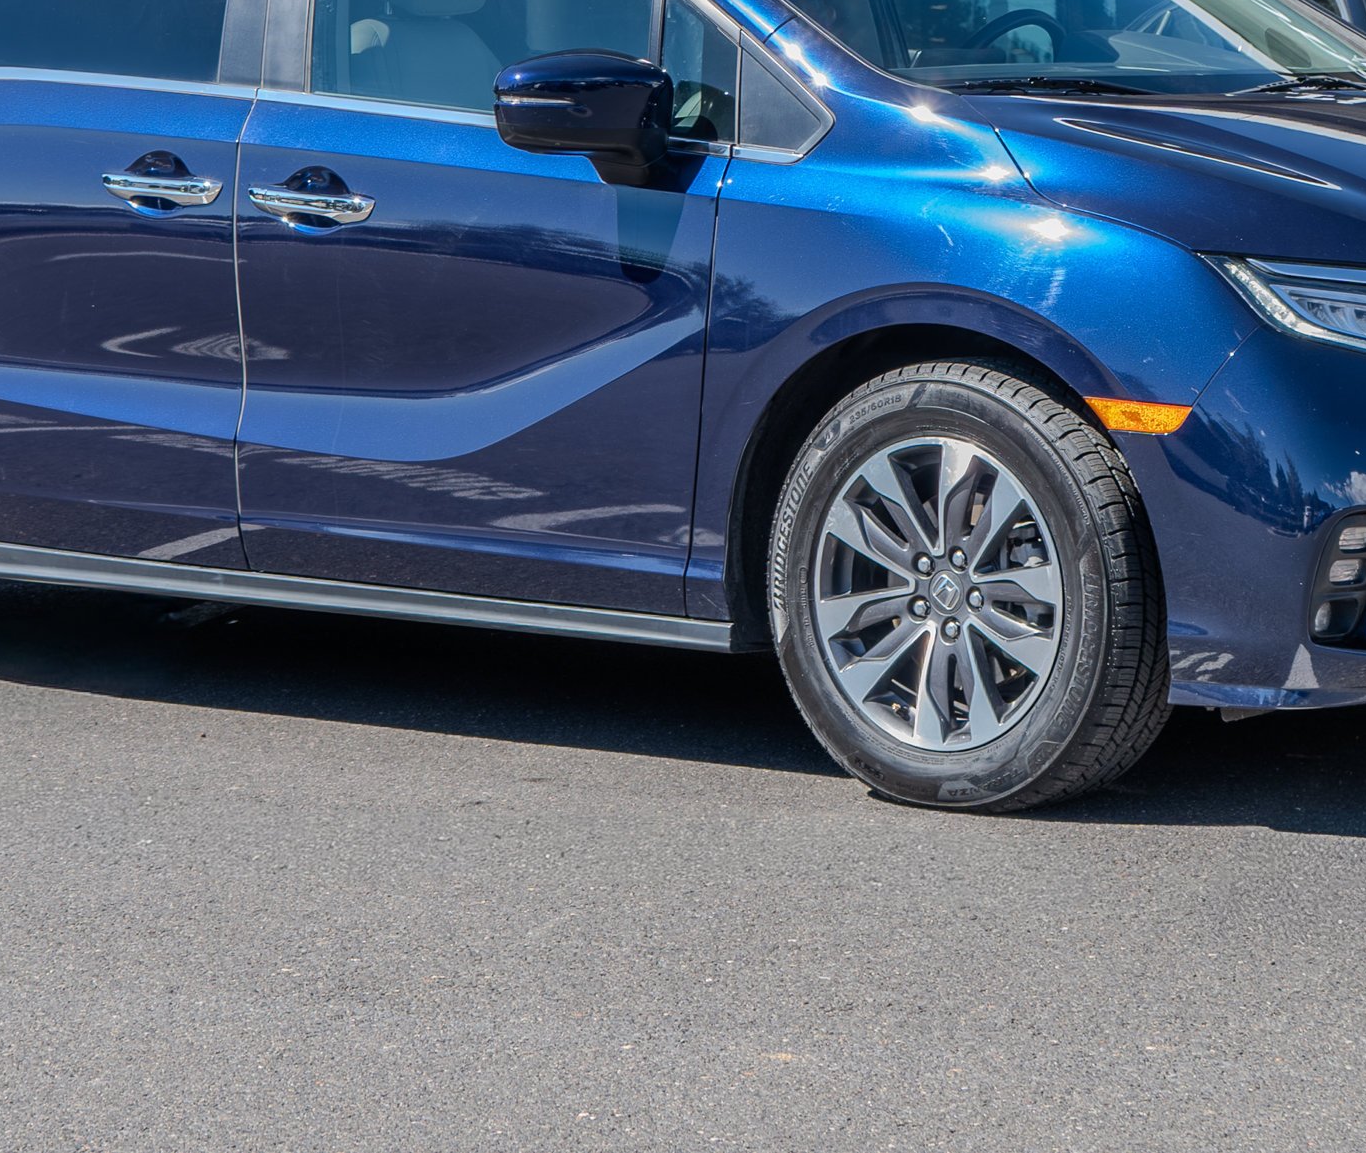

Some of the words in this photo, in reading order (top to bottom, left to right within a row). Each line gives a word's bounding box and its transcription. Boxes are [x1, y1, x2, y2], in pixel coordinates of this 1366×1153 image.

[849, 394, 902, 425] 235/60R18
[772, 461, 814, 611] BRIDGESTONE
[1056, 573, 1100, 729] BRIDGESTONE
